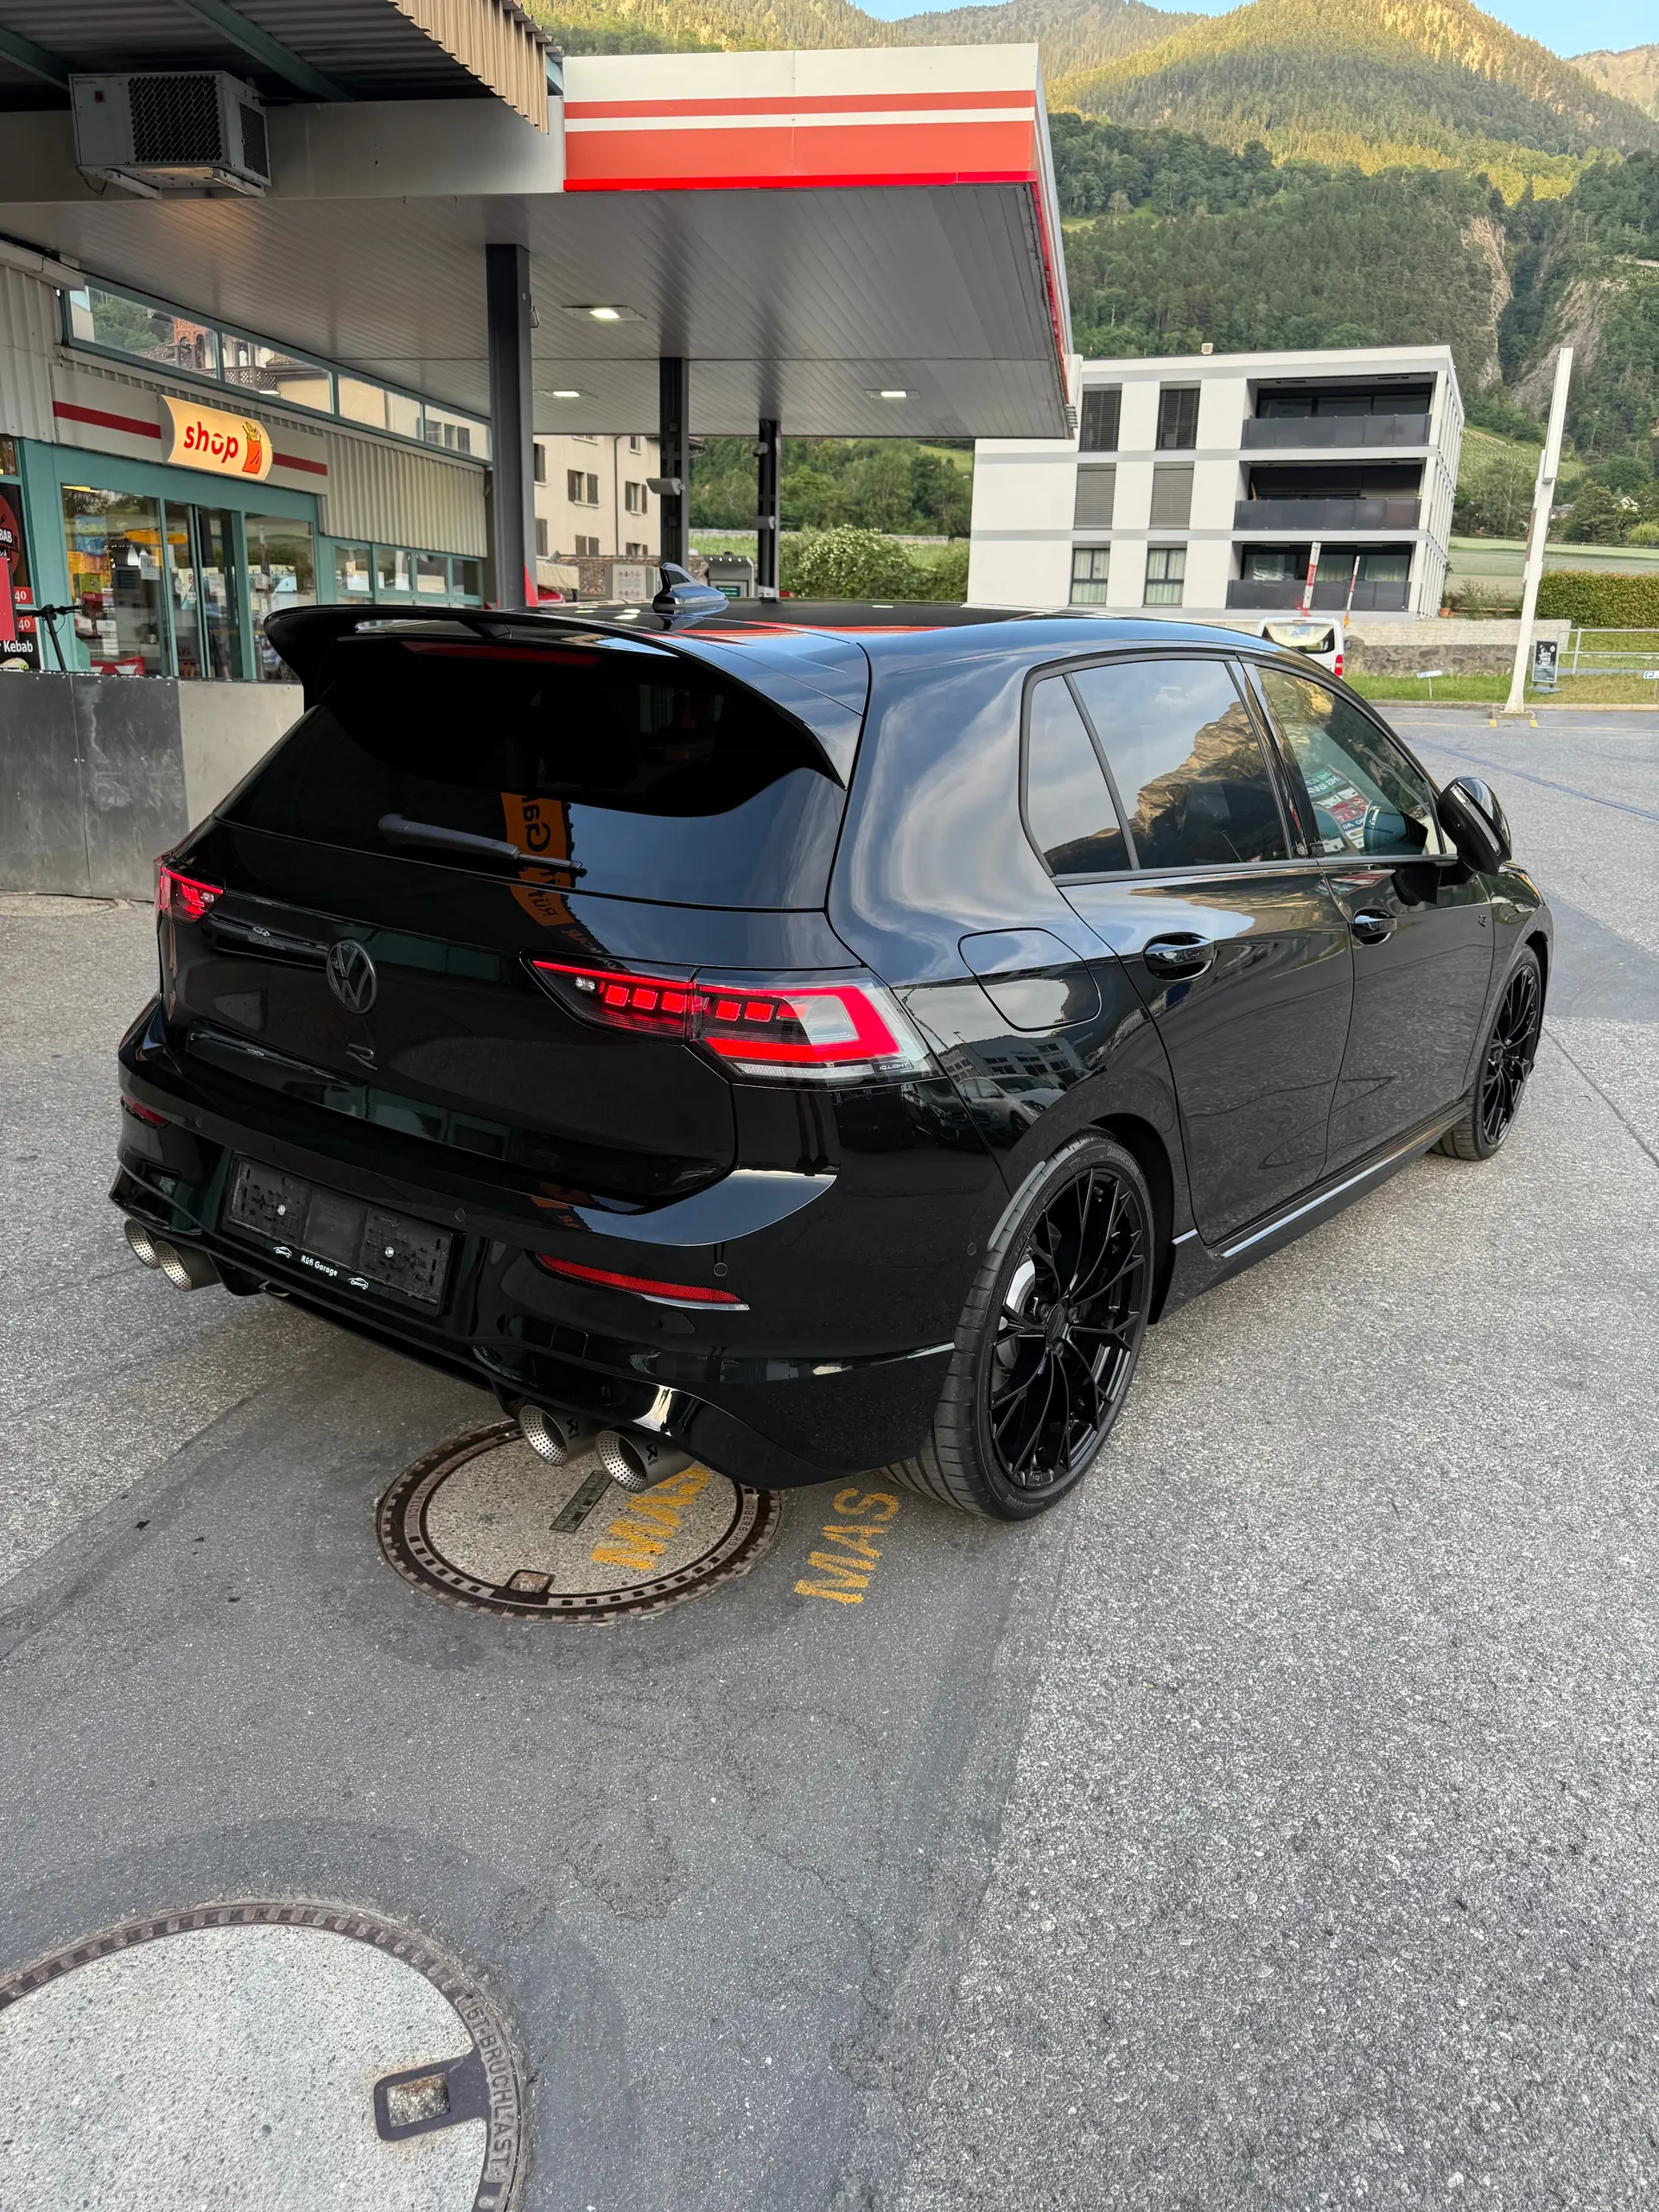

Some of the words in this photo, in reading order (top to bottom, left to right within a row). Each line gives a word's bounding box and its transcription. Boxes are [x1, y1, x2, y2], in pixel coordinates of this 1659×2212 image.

[183, 421, 238, 464] shop
[3, 640, 34, 653] Kebab
[1106, 1145, 1140, 1177] BRIDGESTONE
[315, 1261, 338, 1277] Garage
[793, 1487, 900, 1605] MAS
